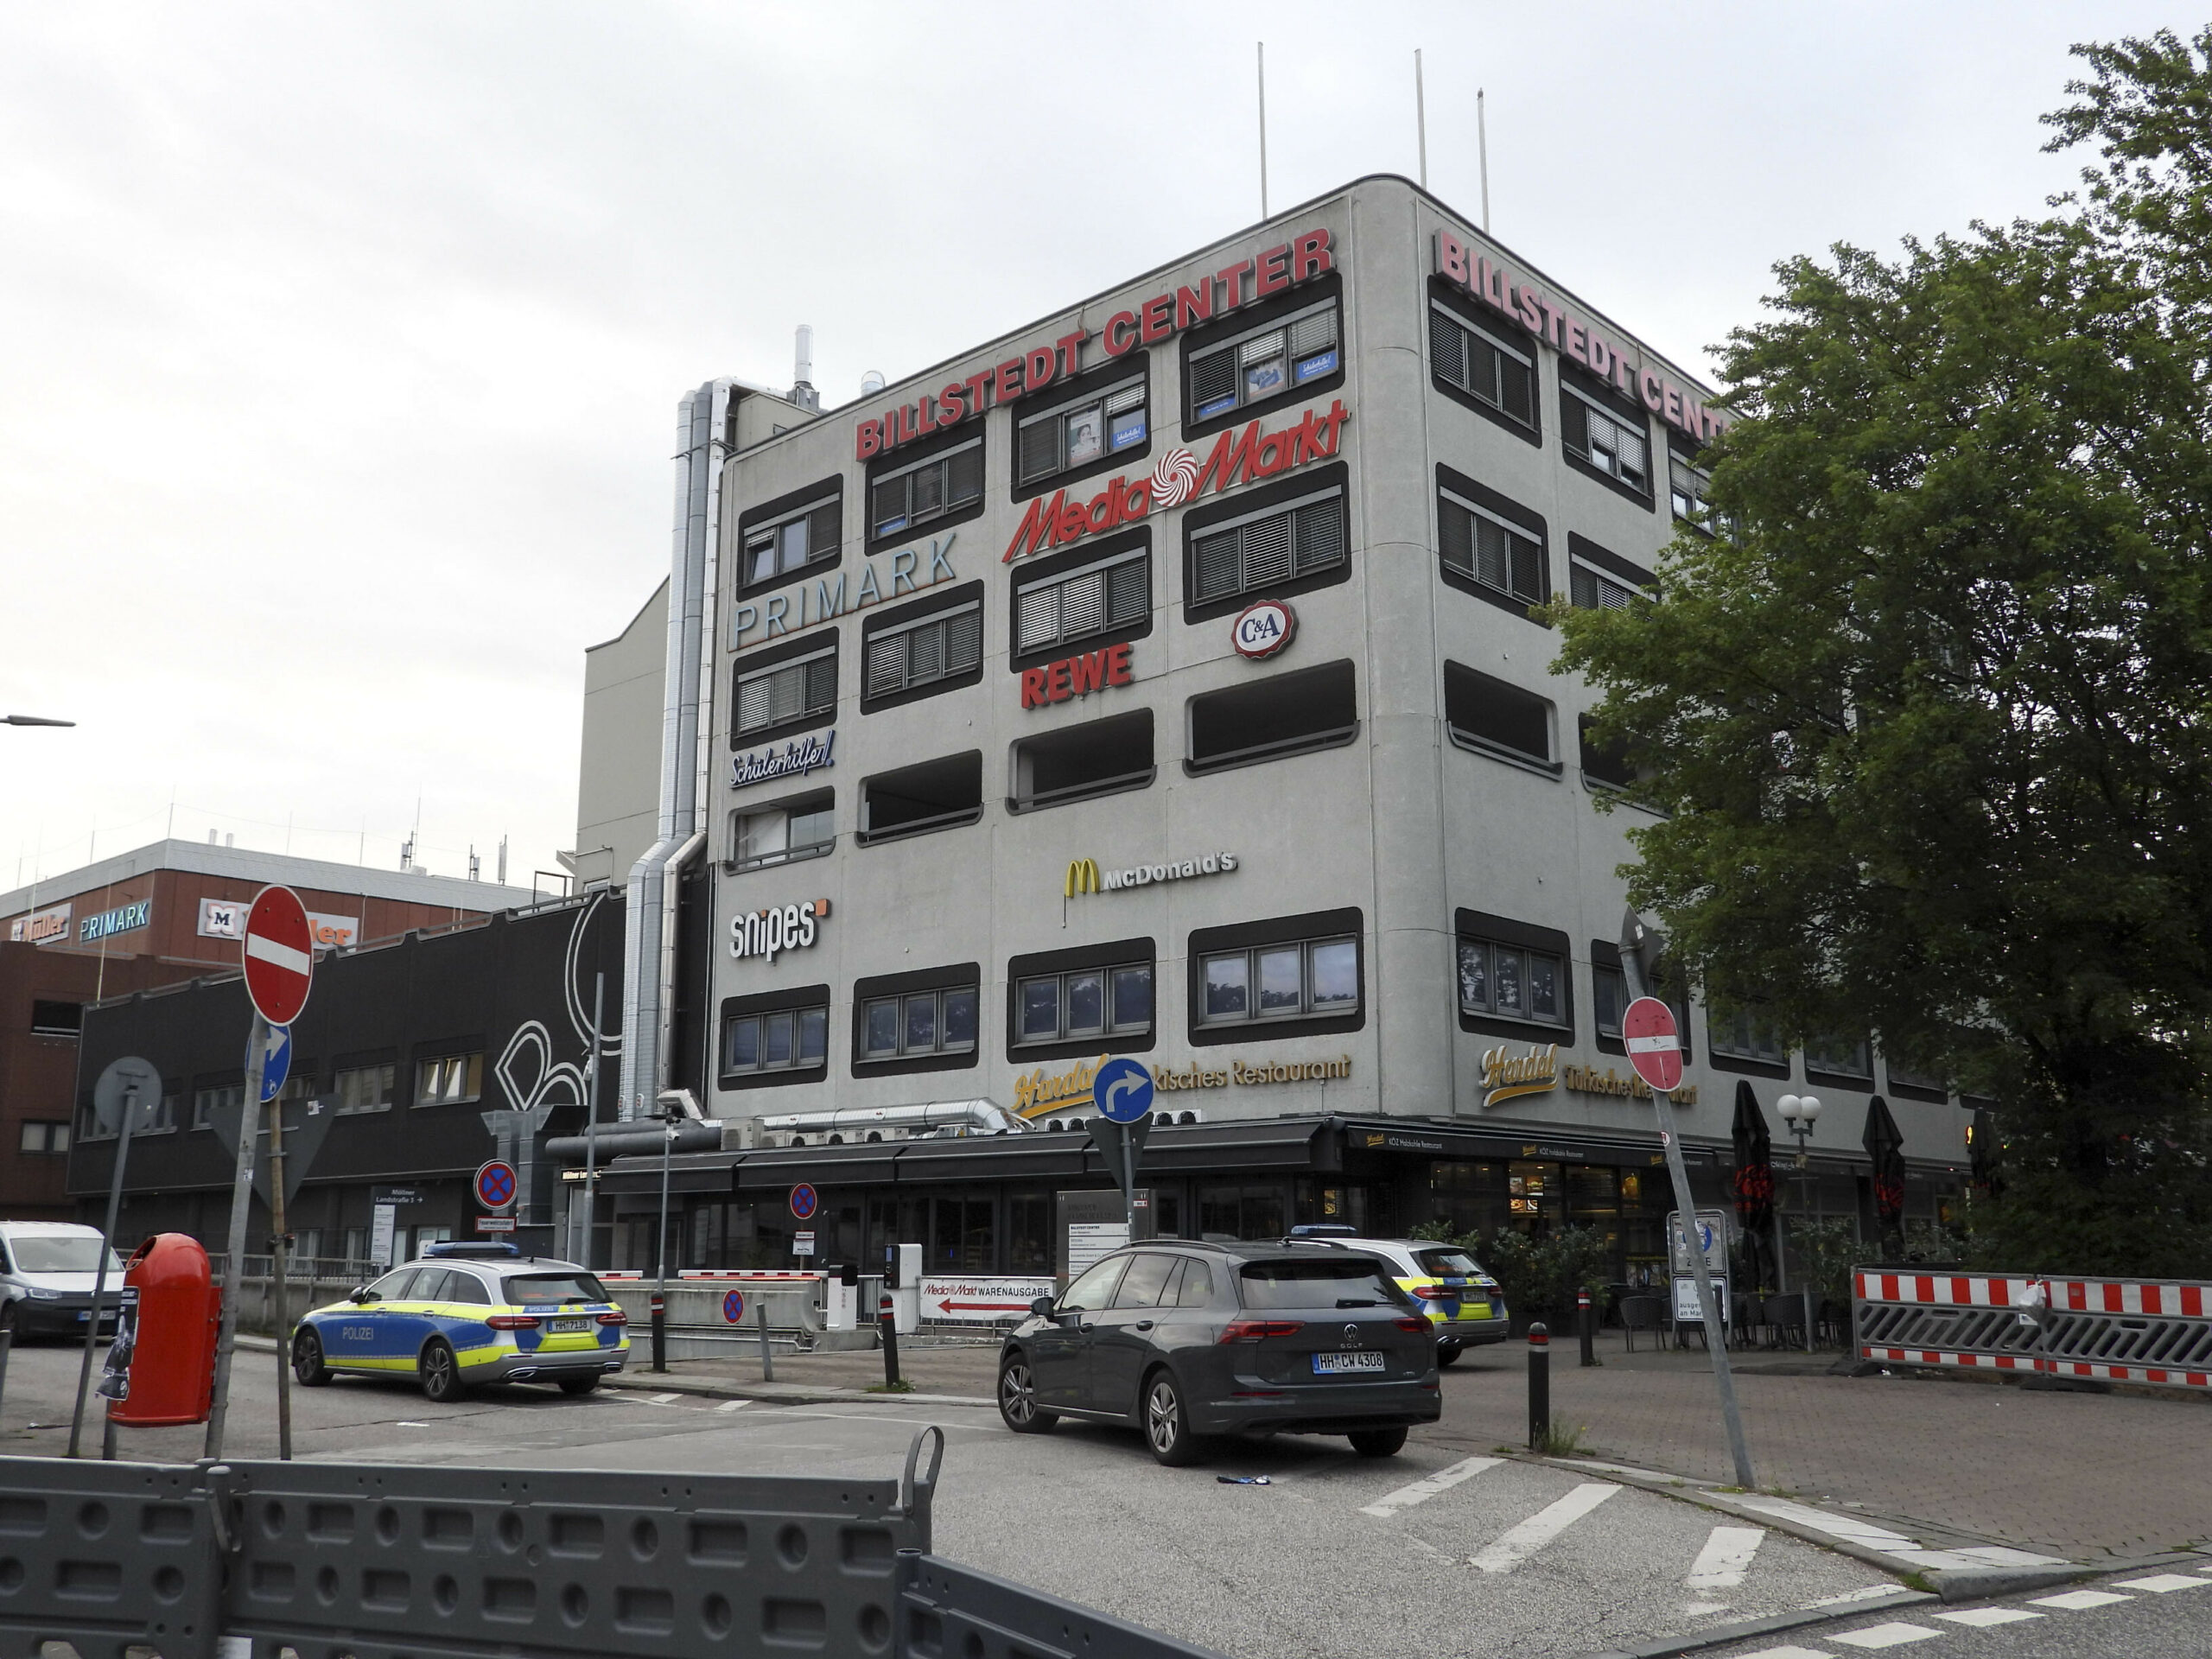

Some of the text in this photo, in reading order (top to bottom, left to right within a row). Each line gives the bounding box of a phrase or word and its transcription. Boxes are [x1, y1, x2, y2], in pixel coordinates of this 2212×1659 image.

[855, 227, 1333, 461] BILLSTEDT CENTER
[1436, 228, 1729, 441] BILLSTEDT CENT
[1001, 399, 1348, 563] Media Markt
[734, 532, 957, 649] PRIMARK
[1239, 612, 1281, 645] C&A
[1021, 643, 1134, 709] REWE
[730, 729, 836, 786] Schülerhilfe!
[1103, 851, 1238, 891] McDonald's
[23, 916, 66, 941] Müller
[79, 901, 149, 942] PRIMARK
[729, 900, 816, 962] snipes
[1151, 1061, 1229, 1091] kisches
[1231, 1054, 1351, 1086] Restaurant
[1478, 1043, 1558, 1089] Hardal
[1631, 1072, 1698, 1105] Reurant
[1687, 1257, 1712, 1267] ZE
[924, 1283, 1049, 1297] Media Markt WARENAUSGABE
[342, 1326, 374, 1340] POLIZEI
[556, 1320, 588, 1330] HH 7138
[1320, 1353, 1382, 1369] HH CW 4308
